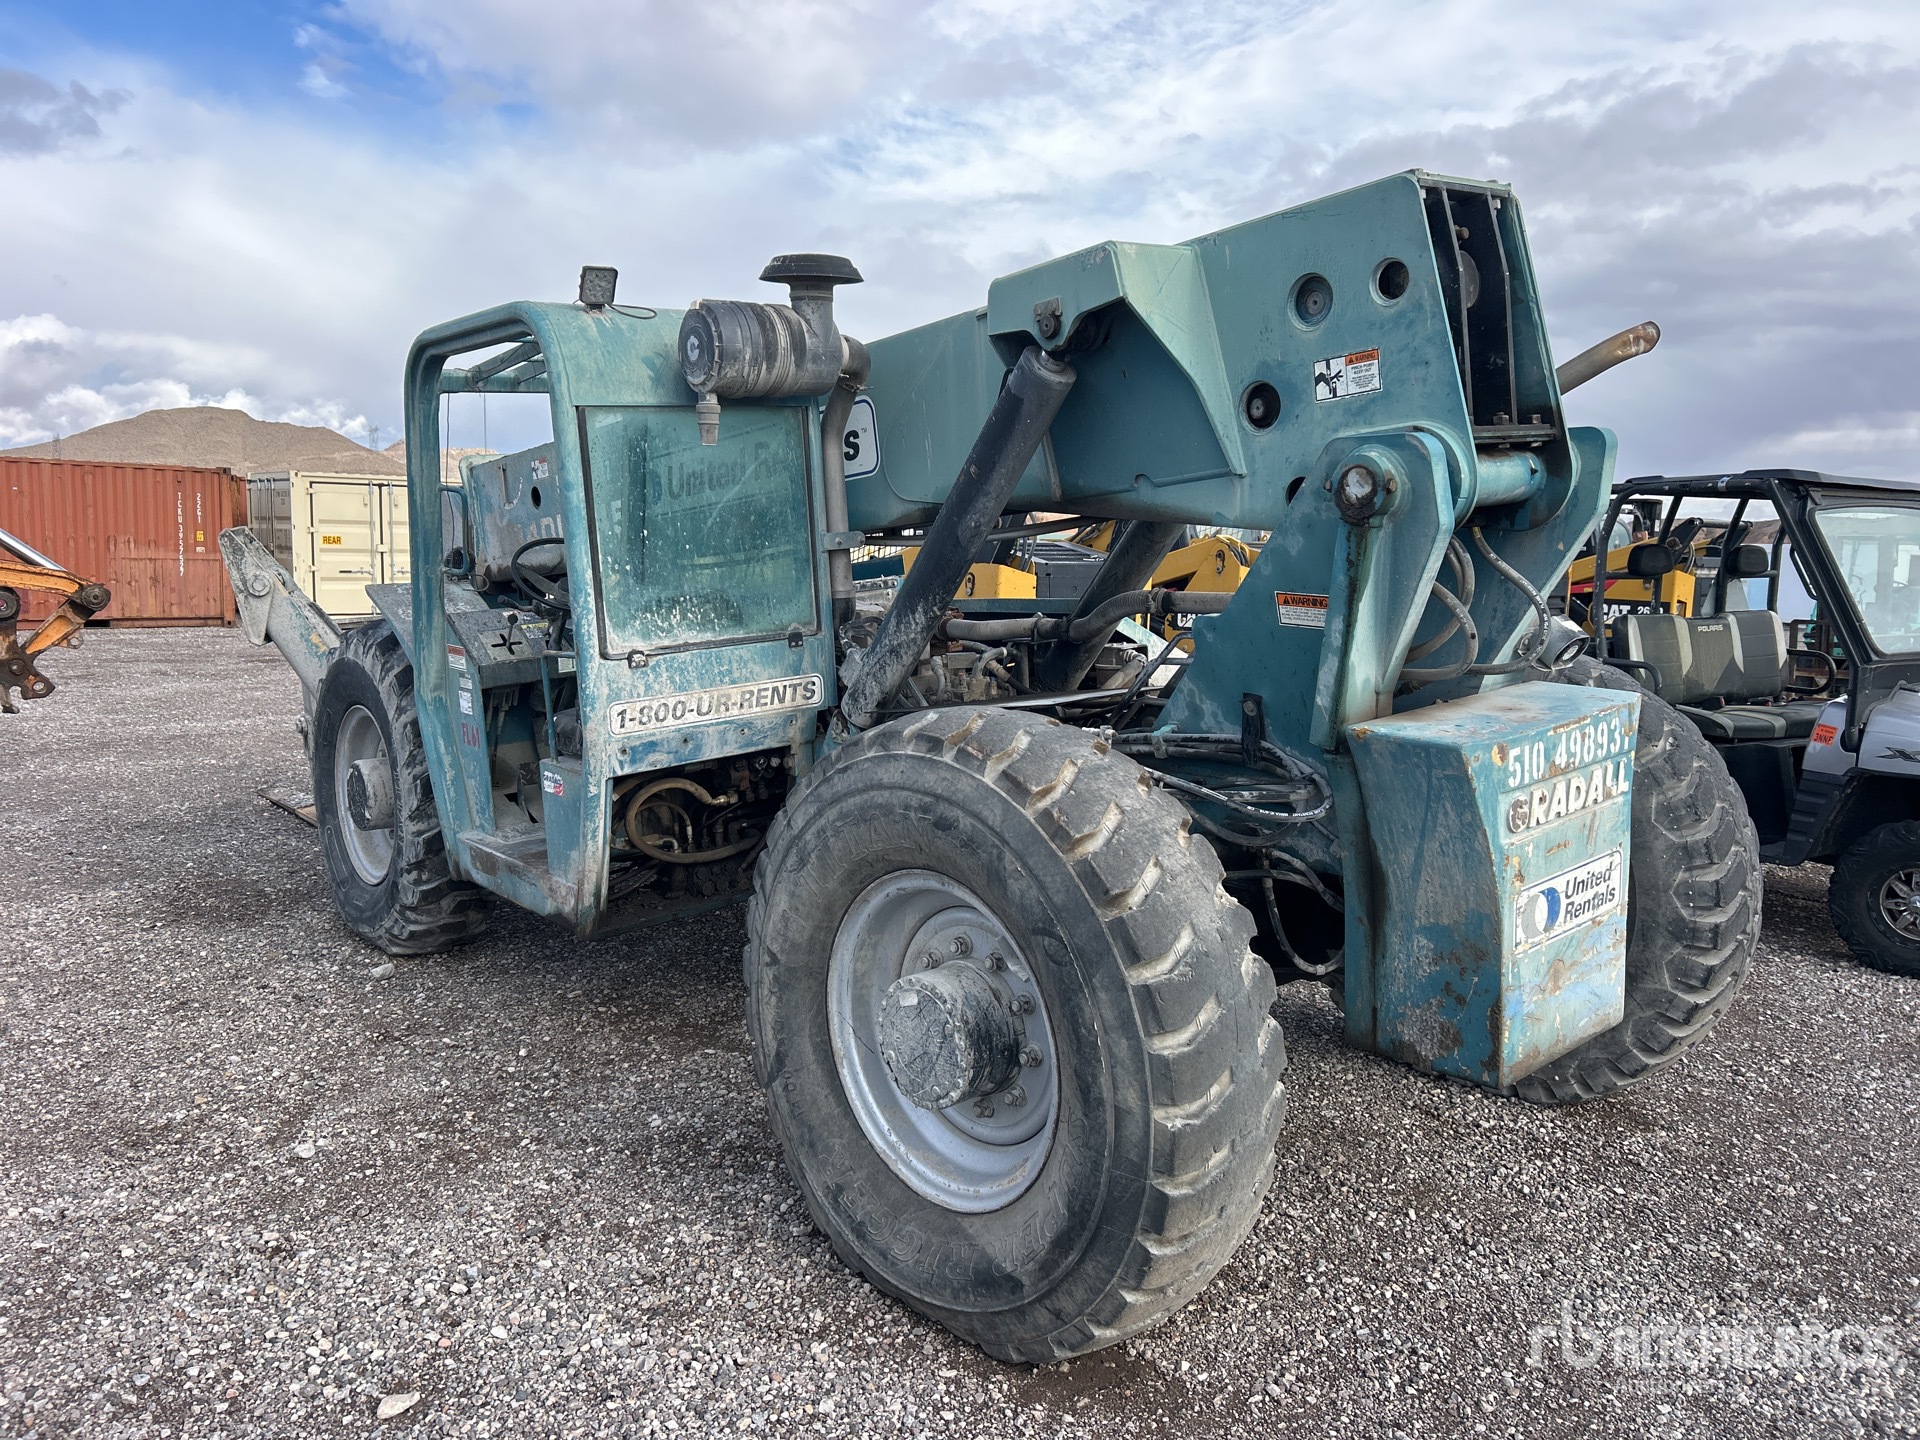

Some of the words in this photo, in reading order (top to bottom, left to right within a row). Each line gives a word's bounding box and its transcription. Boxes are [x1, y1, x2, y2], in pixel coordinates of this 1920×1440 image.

[322, 535, 342, 545] REAR
[1697, 625, 1723, 633] POLARIS
[615, 680, 817, 730] 1-800-UR-RENTS
[1508, 740, 1545, 788] 510
[1509, 758, 1630, 833] GRADALL
[787, 810, 933, 902] TITAN
[1565, 861, 1613, 900] United
[1564, 884, 1616, 923] Rentals
